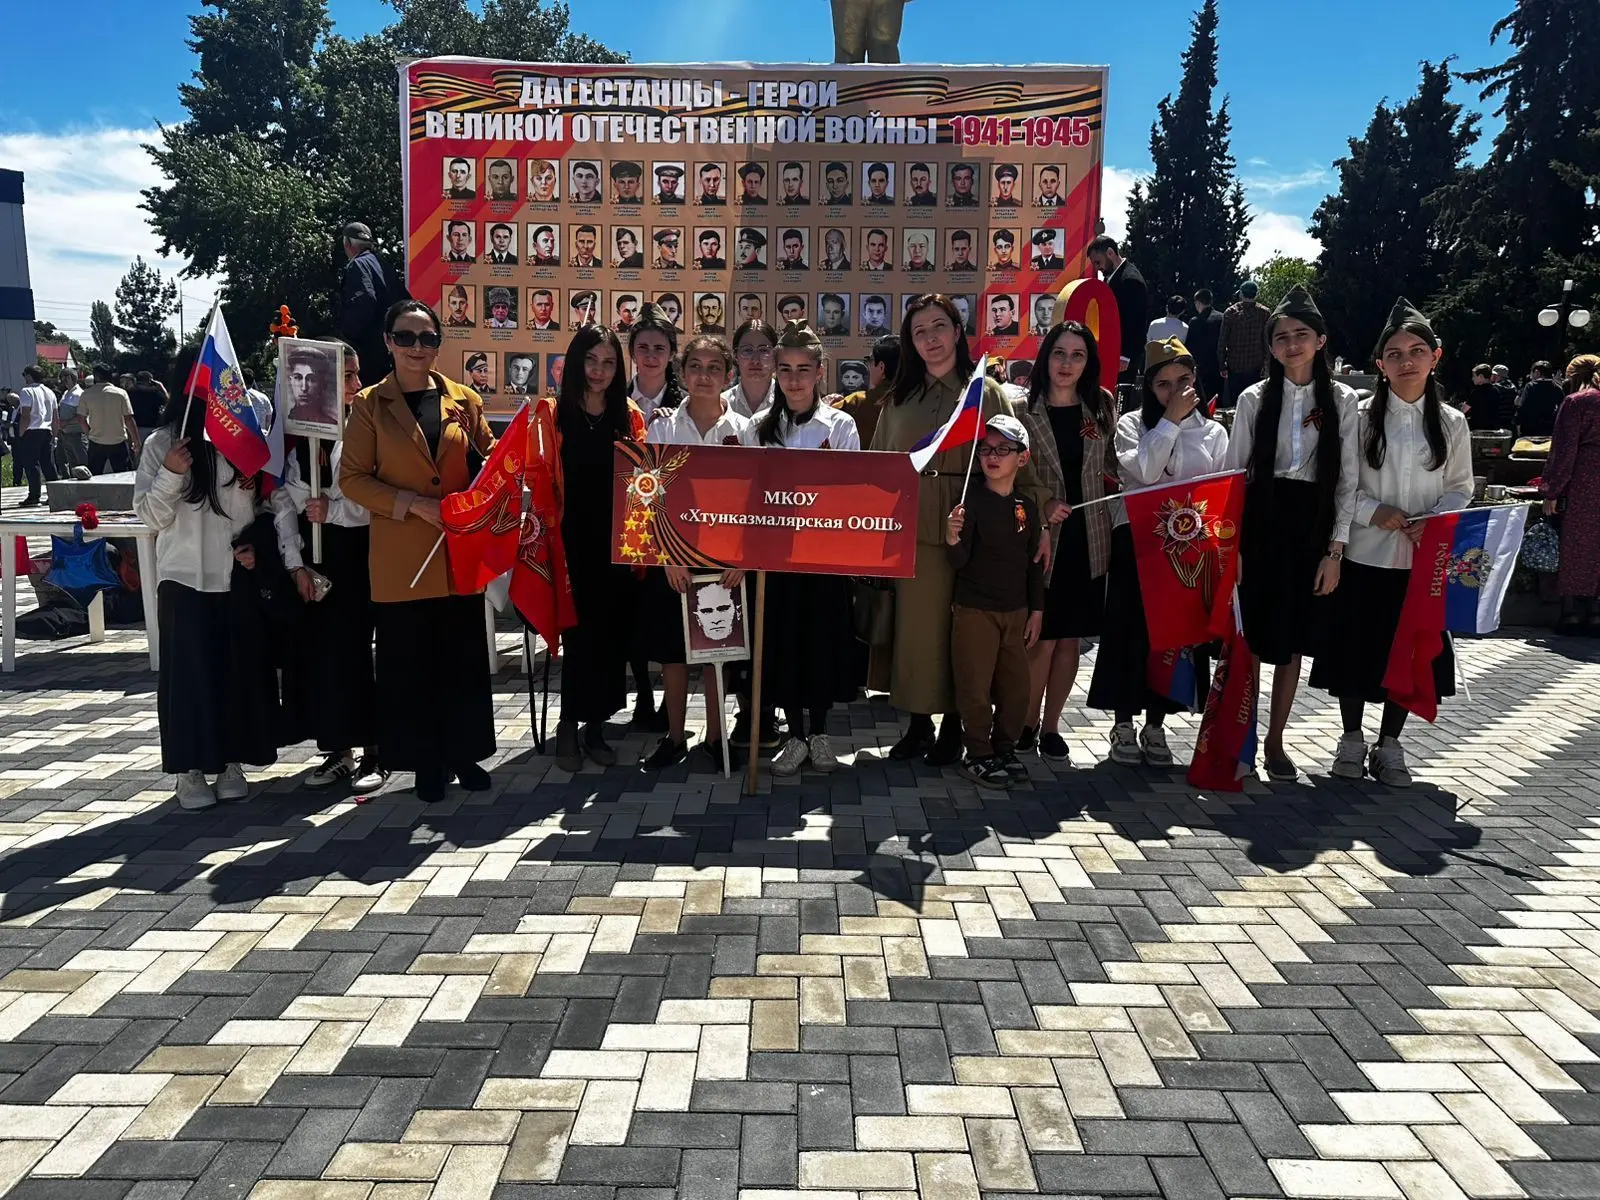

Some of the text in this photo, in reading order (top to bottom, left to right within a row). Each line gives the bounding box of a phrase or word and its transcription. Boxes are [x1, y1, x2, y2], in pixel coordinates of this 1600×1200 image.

[519, 76, 722, 111] ДАГЕСТАНЦЫ
[748, 80, 837, 107] ГЕРОИ
[425, 109, 1091, 147] ВЕЛИКОЙ ОТЕЧЕСТВЕННОЙ ВОЙНЫ 1941-1945
[764, 490, 819, 506] МКОУ
[679, 508, 903, 531] «Хтунказмалярская ООШ»
[1430, 542, 1449, 597] РОССИЯ
